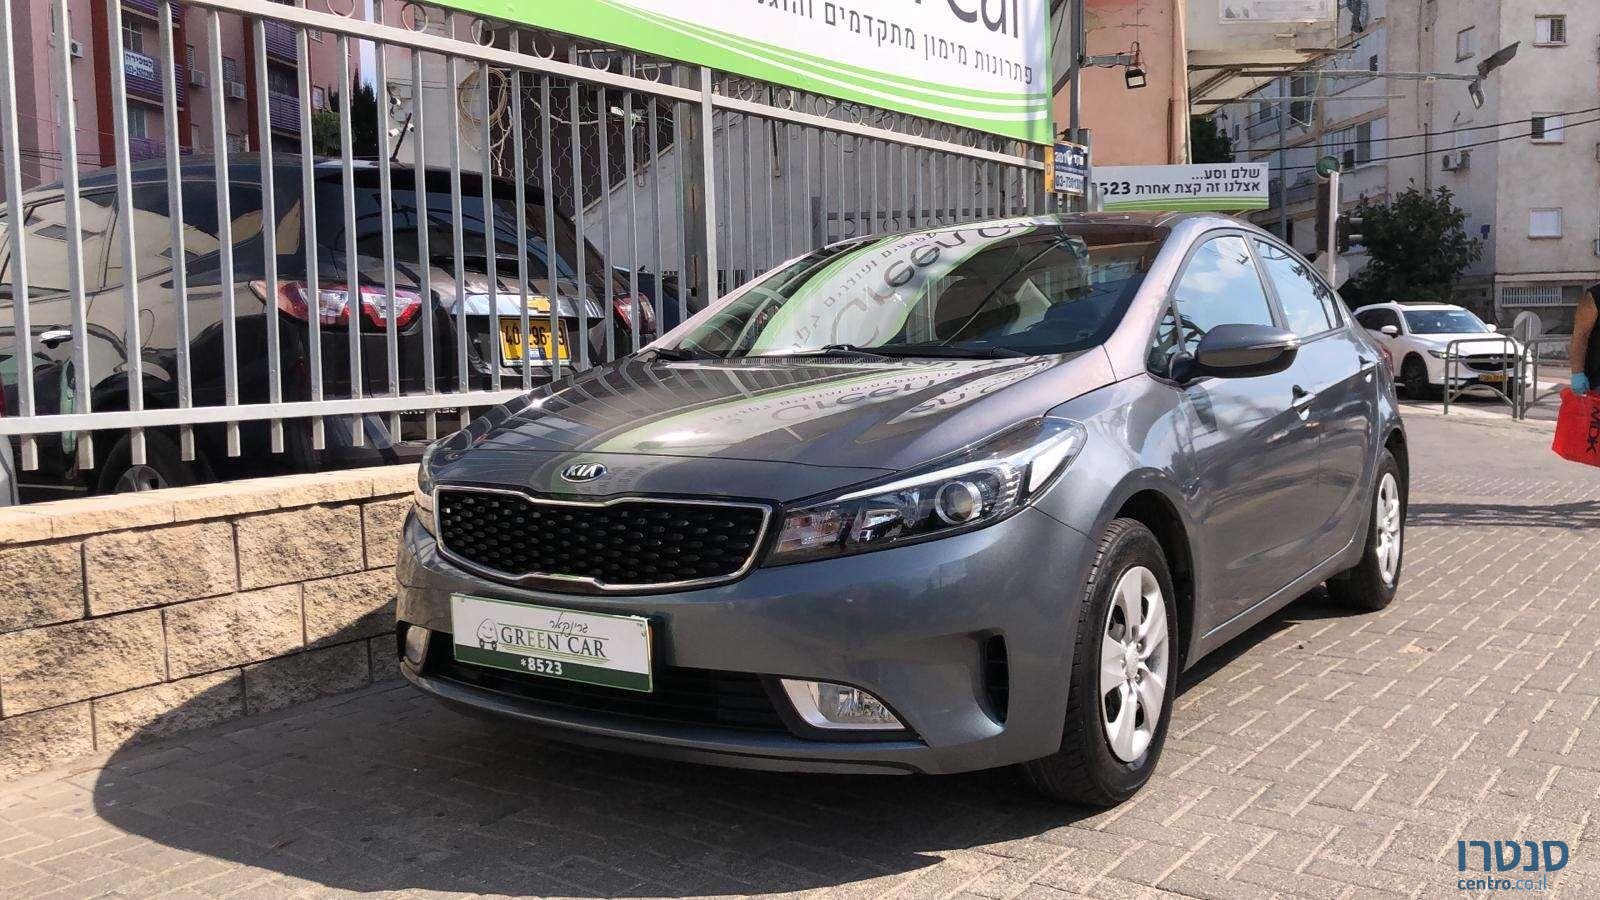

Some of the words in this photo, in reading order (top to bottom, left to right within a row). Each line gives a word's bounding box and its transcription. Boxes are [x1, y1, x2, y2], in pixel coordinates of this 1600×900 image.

[825, 2, 915, 50] מתקדמים
[923, 33, 967, 66] מימון
[974, 50, 1033, 85] פתרונות
[1191, 169, 1227, 180] וסע...
[1231, 167, 1260, 179] שלם
[1092, 181, 1131, 195] 523
[1135, 183, 1171, 195] אחרת
[1174, 182, 1202, 196] קצת
[1206, 182, 1220, 193] זה
[1224, 180, 1260, 193] אצלנו
[566, 464, 600, 477] KIA
[501, 626, 560, 651] GREEN
[567, 635, 607, 658] CAR
